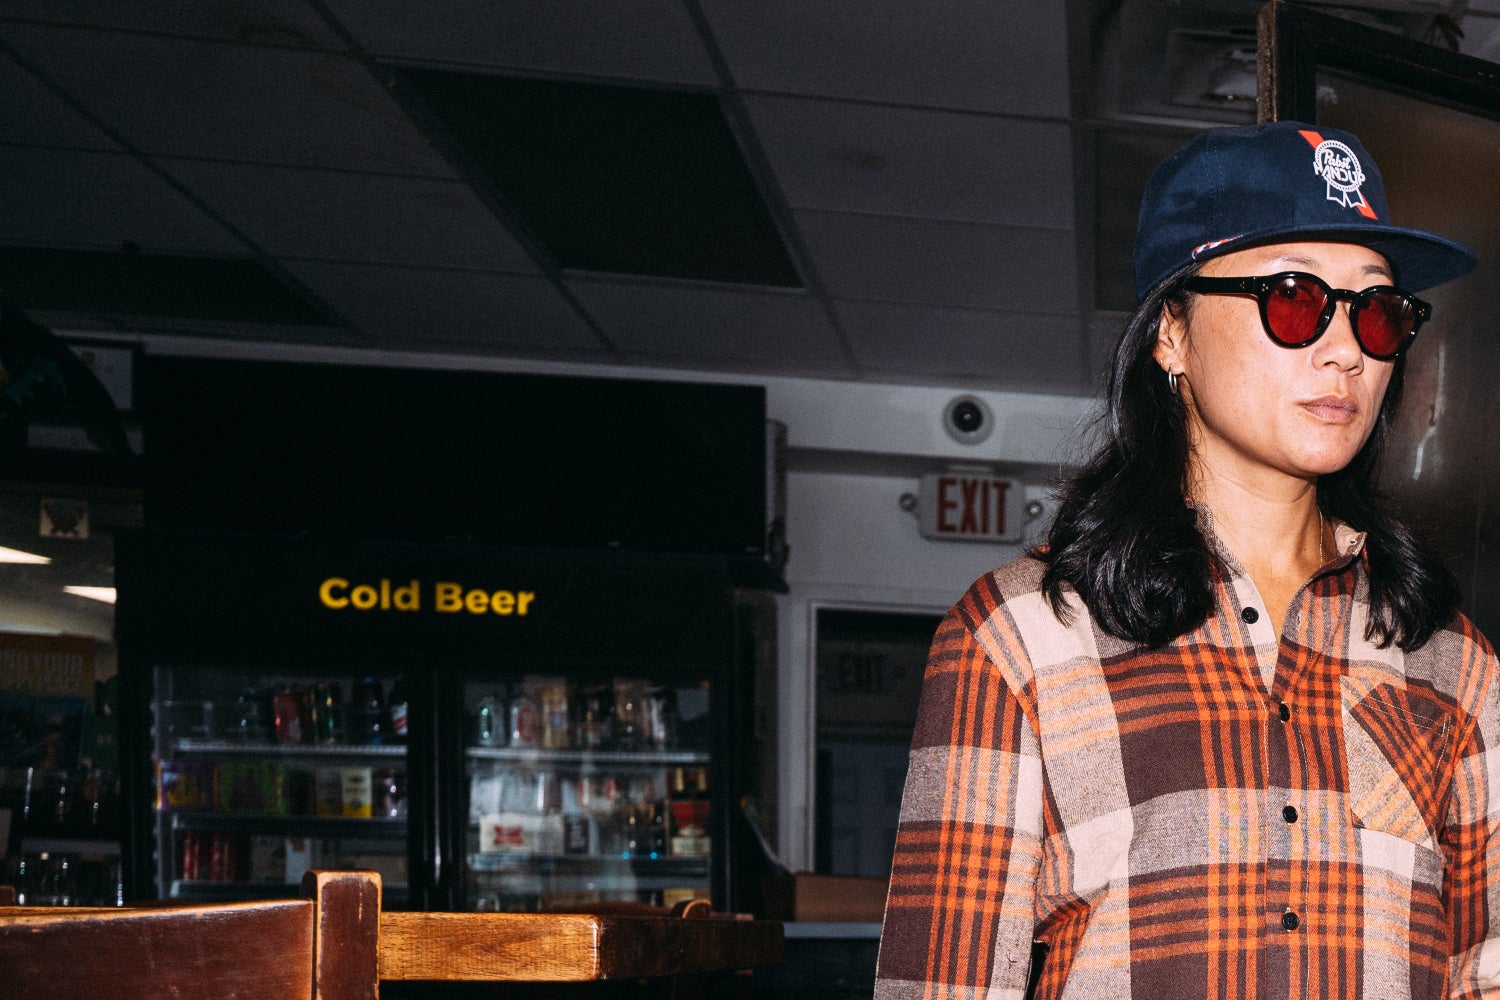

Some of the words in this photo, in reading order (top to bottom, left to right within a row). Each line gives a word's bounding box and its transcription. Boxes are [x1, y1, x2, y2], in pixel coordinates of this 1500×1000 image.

[1312, 161, 1366, 186] HANDUP
[1320, 148, 1352, 169] Pabst
[936, 478, 1011, 534] EXIT
[319, 577, 420, 612] Cold
[434, 582, 535, 616] Beer
